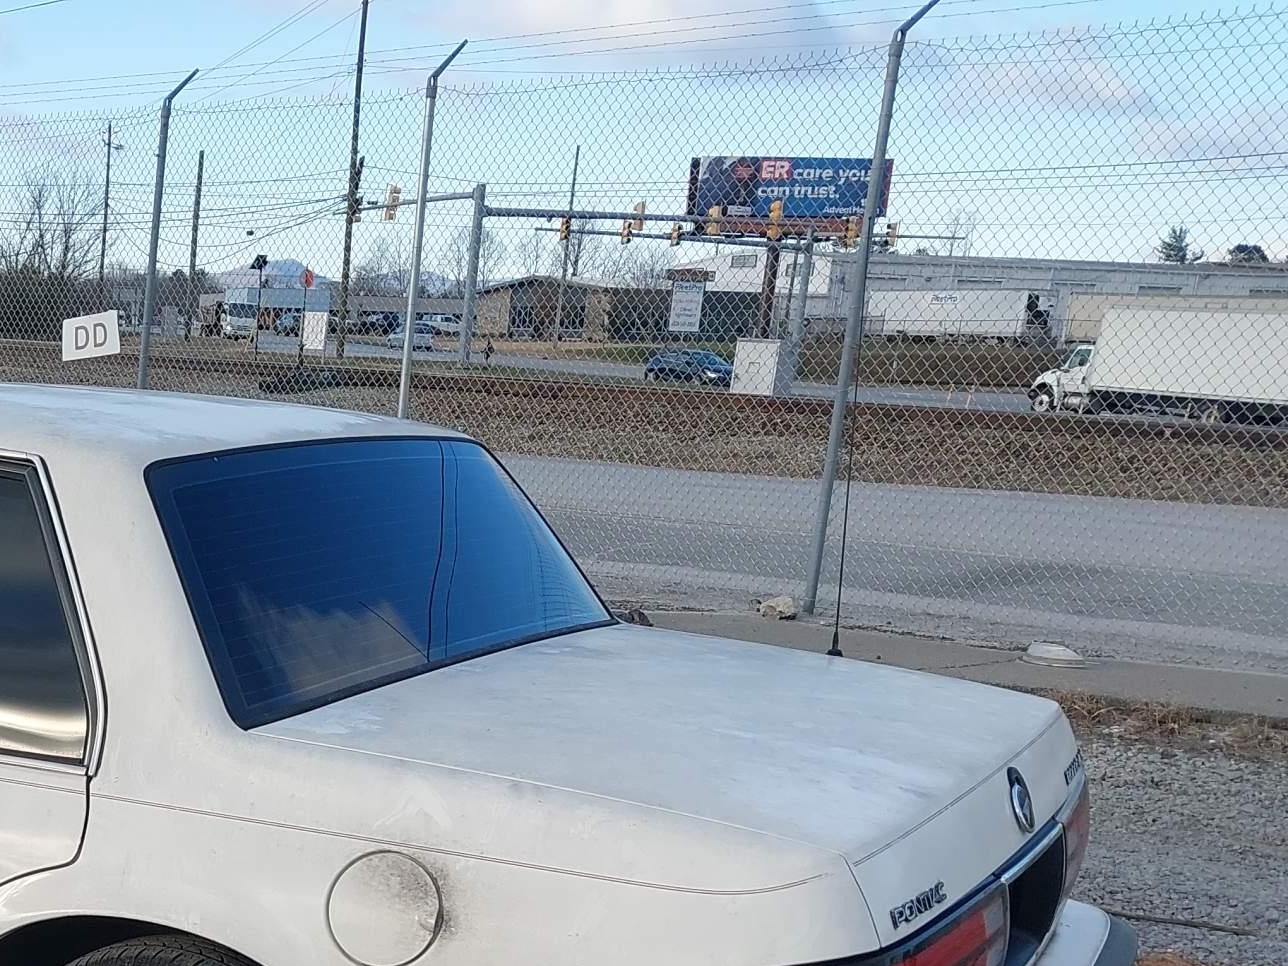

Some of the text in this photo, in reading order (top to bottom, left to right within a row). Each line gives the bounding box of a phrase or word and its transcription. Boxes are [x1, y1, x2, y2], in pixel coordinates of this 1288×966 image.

[761, 160, 873, 185] ER care you
[757, 184, 840, 198] can trust.
[889, 880, 948, 930] PONTIAC
